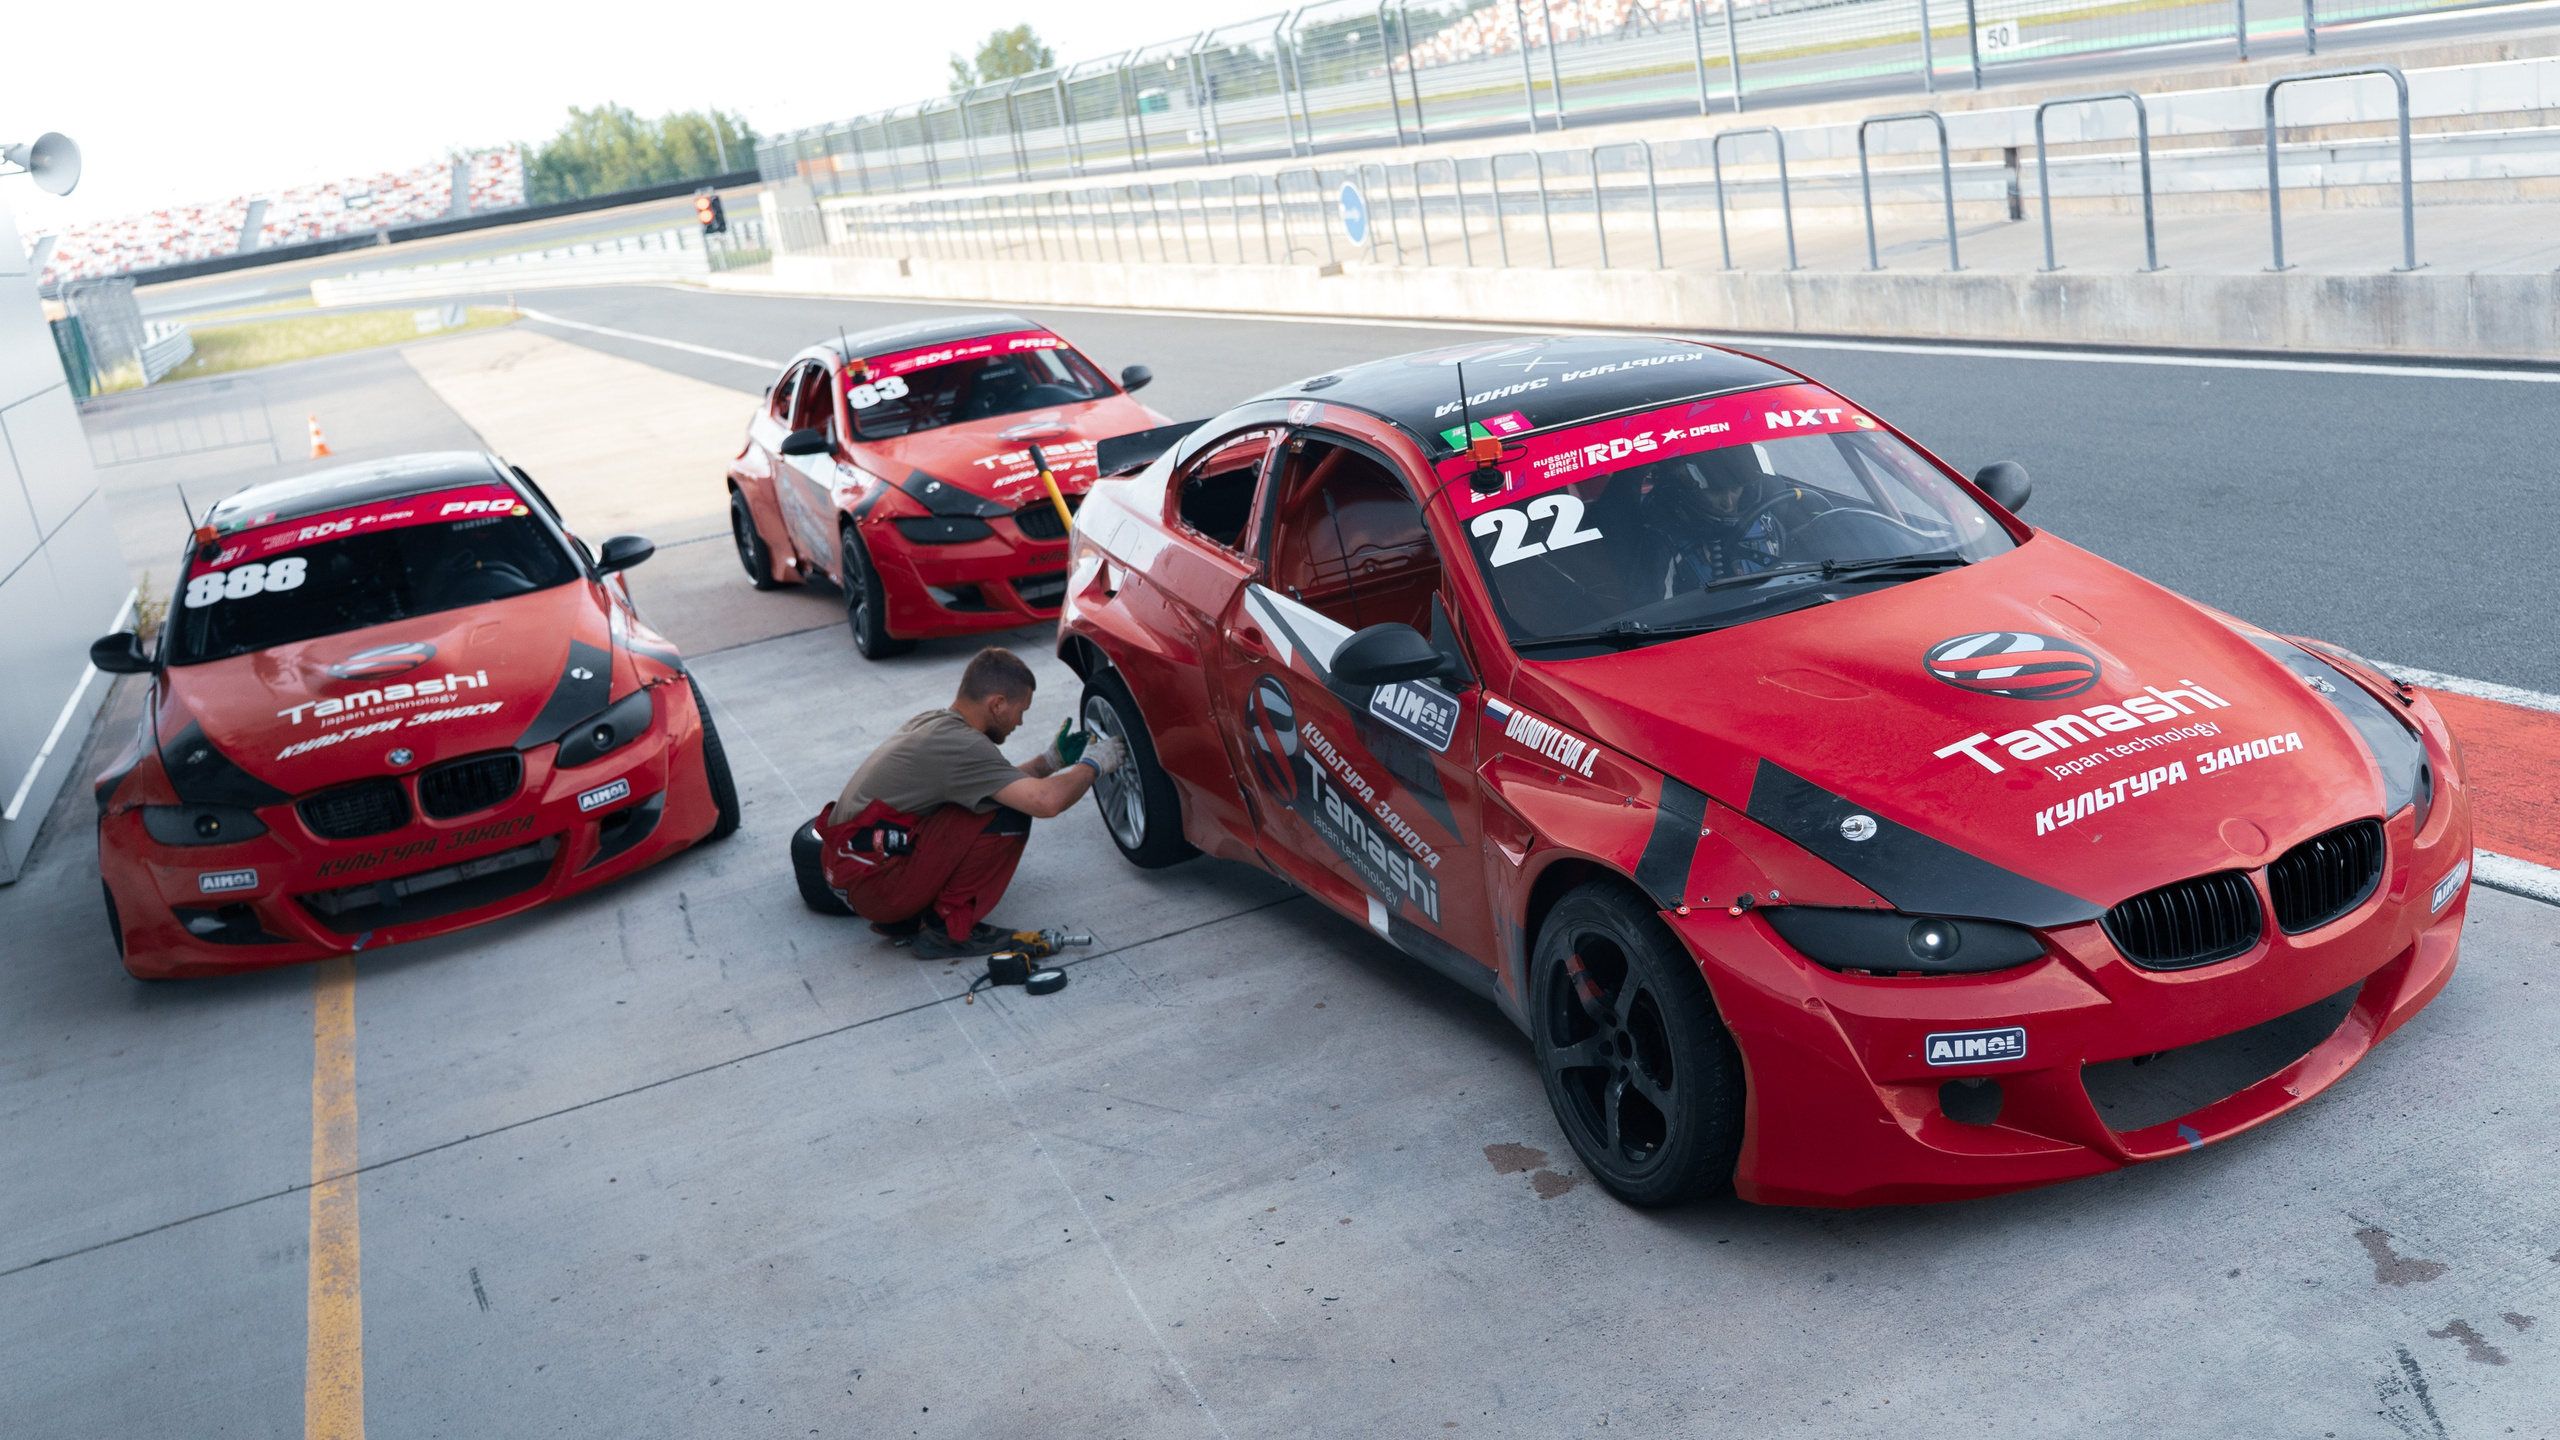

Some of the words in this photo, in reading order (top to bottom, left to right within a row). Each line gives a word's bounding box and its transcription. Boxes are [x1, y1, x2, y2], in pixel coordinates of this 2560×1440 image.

[1987, 26, 2009, 49] 50
[1561, 352, 1703, 383] КУЛЬТУРА
[847, 376, 909, 409] 83
[1434, 377, 1550, 419] ЗАНОСА
[1764, 408, 1843, 430] NXT
[972, 439, 1098, 470] Taash
[1533, 450, 1577, 469] RUSSIAN
[1548, 457, 1578, 471] DRIFT
[1583, 431, 1658, 466] RDS
[1689, 421, 1731, 438] OPEN
[1543, 462, 1580, 479] SERIES
[439, 498, 516, 516] PRO
[297, 516, 357, 542] RDS
[1470, 494, 1604, 568] 22
[184, 556, 308, 609] 888
[276, 670, 489, 726] Tamashi
[368, 692, 459, 716] technology
[1374, 683, 1449, 741] AIMOL
[275, 717, 404, 762] КУЛЬТУРА
[405, 701, 504, 728] ЗАНОСА
[1504, 709, 1587, 771] DANDYLEVA
[1577, 747, 1600, 778] A.
[1933, 679, 2232, 775] Tamashi
[2045, 751, 2110, 781] Japan
[2104, 719, 2223, 759] technology
[1301, 721, 1375, 804] КУЛЬТУРА
[1374, 800, 1441, 870] ЗАНОСА
[2035, 760, 2189, 837] КУЛЬТУРА
[2196, 731, 2304, 776] ЗАНОСА
[316, 837, 439, 879] КУЛЬТУРА
[445, 814, 536, 850] ЗАНОСА
[1303, 750, 1439, 923] Tamashi
[1313, 810, 1340, 847] Japan
[1340, 839, 1399, 907] technology
[2433, 865, 2464, 907] AIM
[1930, 1035, 2022, 1059] AIMOL
